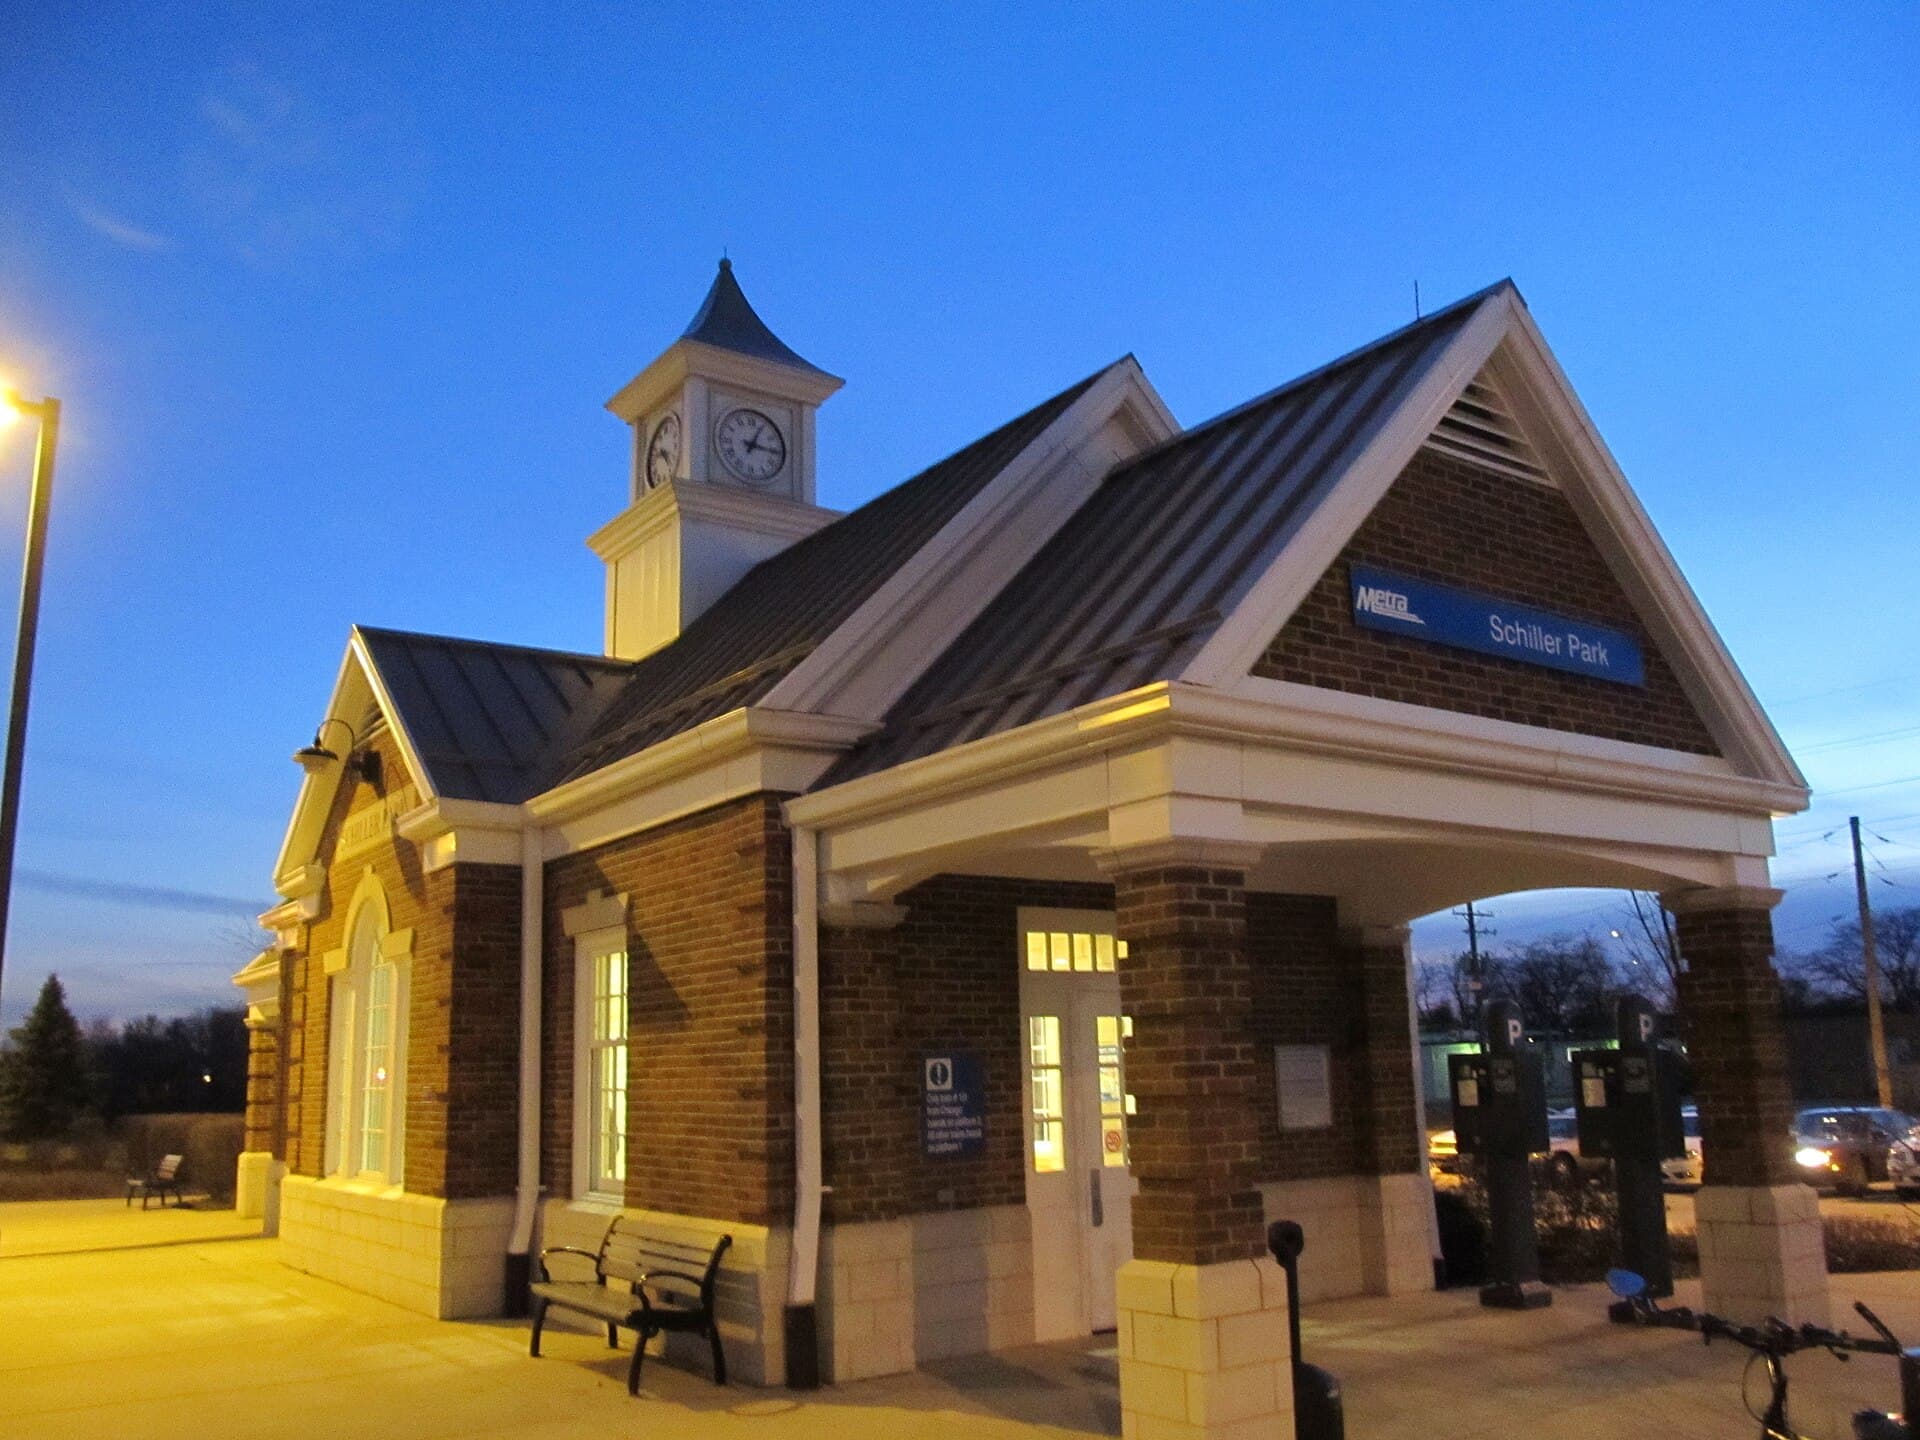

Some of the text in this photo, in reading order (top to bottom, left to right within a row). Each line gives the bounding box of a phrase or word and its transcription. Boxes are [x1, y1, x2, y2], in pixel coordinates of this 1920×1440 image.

[1356, 585, 1409, 613] Metra
[1489, 614, 1610, 666] Schiller Park
[1508, 1019, 1522, 1046] P
[1639, 1013, 1653, 1042] P
